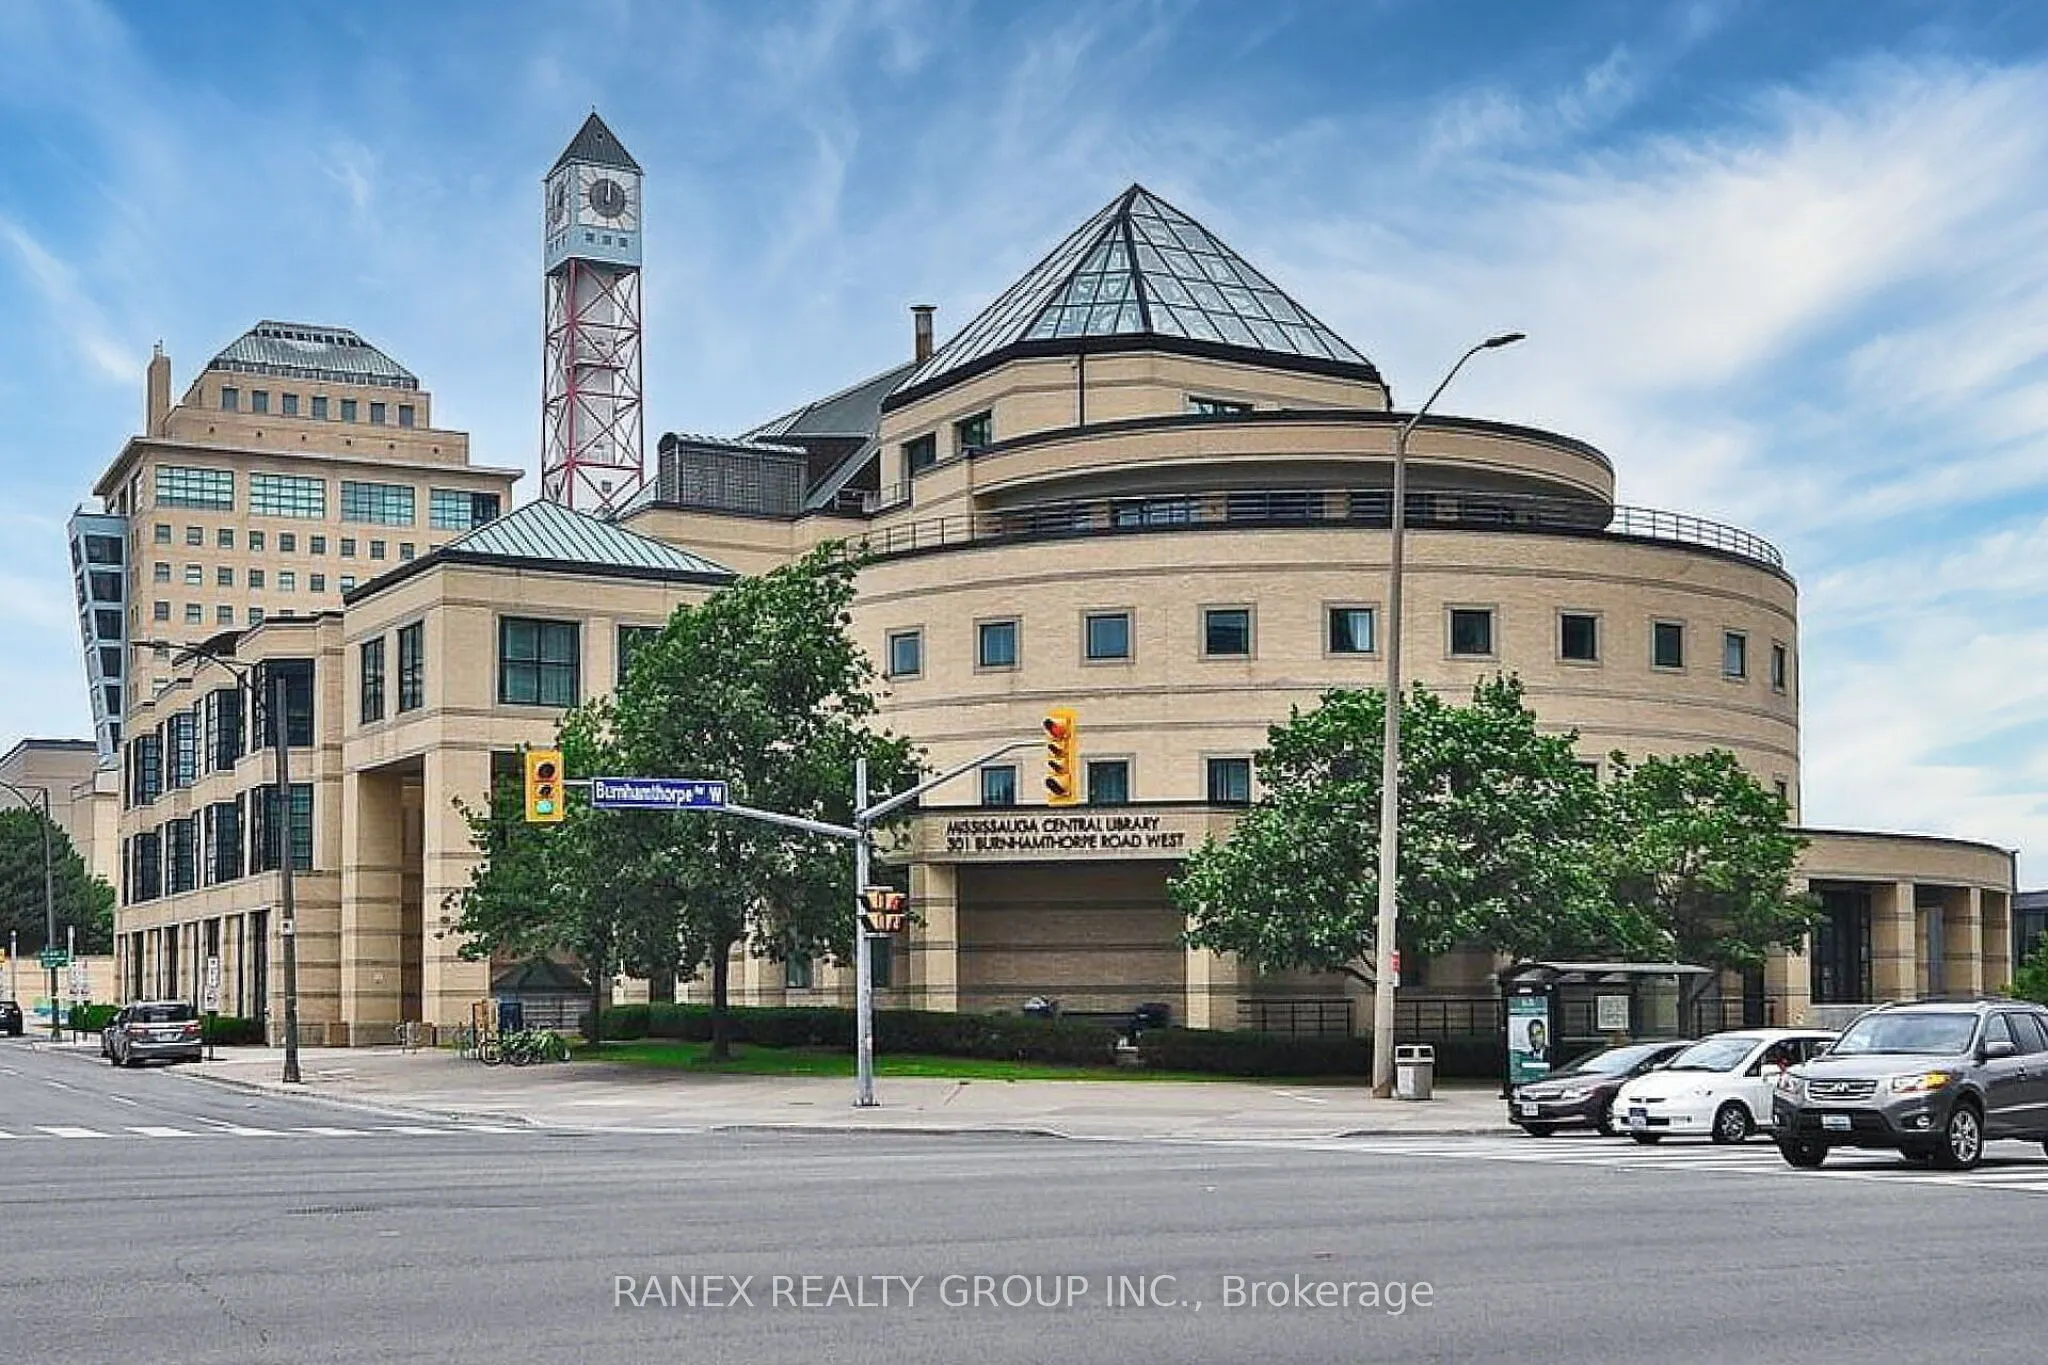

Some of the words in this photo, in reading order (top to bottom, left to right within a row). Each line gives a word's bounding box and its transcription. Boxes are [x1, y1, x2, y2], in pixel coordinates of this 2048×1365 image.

[709, 786, 722, 803] W
[946, 819, 1038, 834] MISSISSAUGA
[1041, 817, 1102, 832] CENTRAL
[1106, 816, 1160, 831] LIBRARY
[975, 834, 1097, 849] BURNHAMTHORPE
[1102, 834, 1141, 848] ROAD
[1146, 833, 1185, 847] WEST
